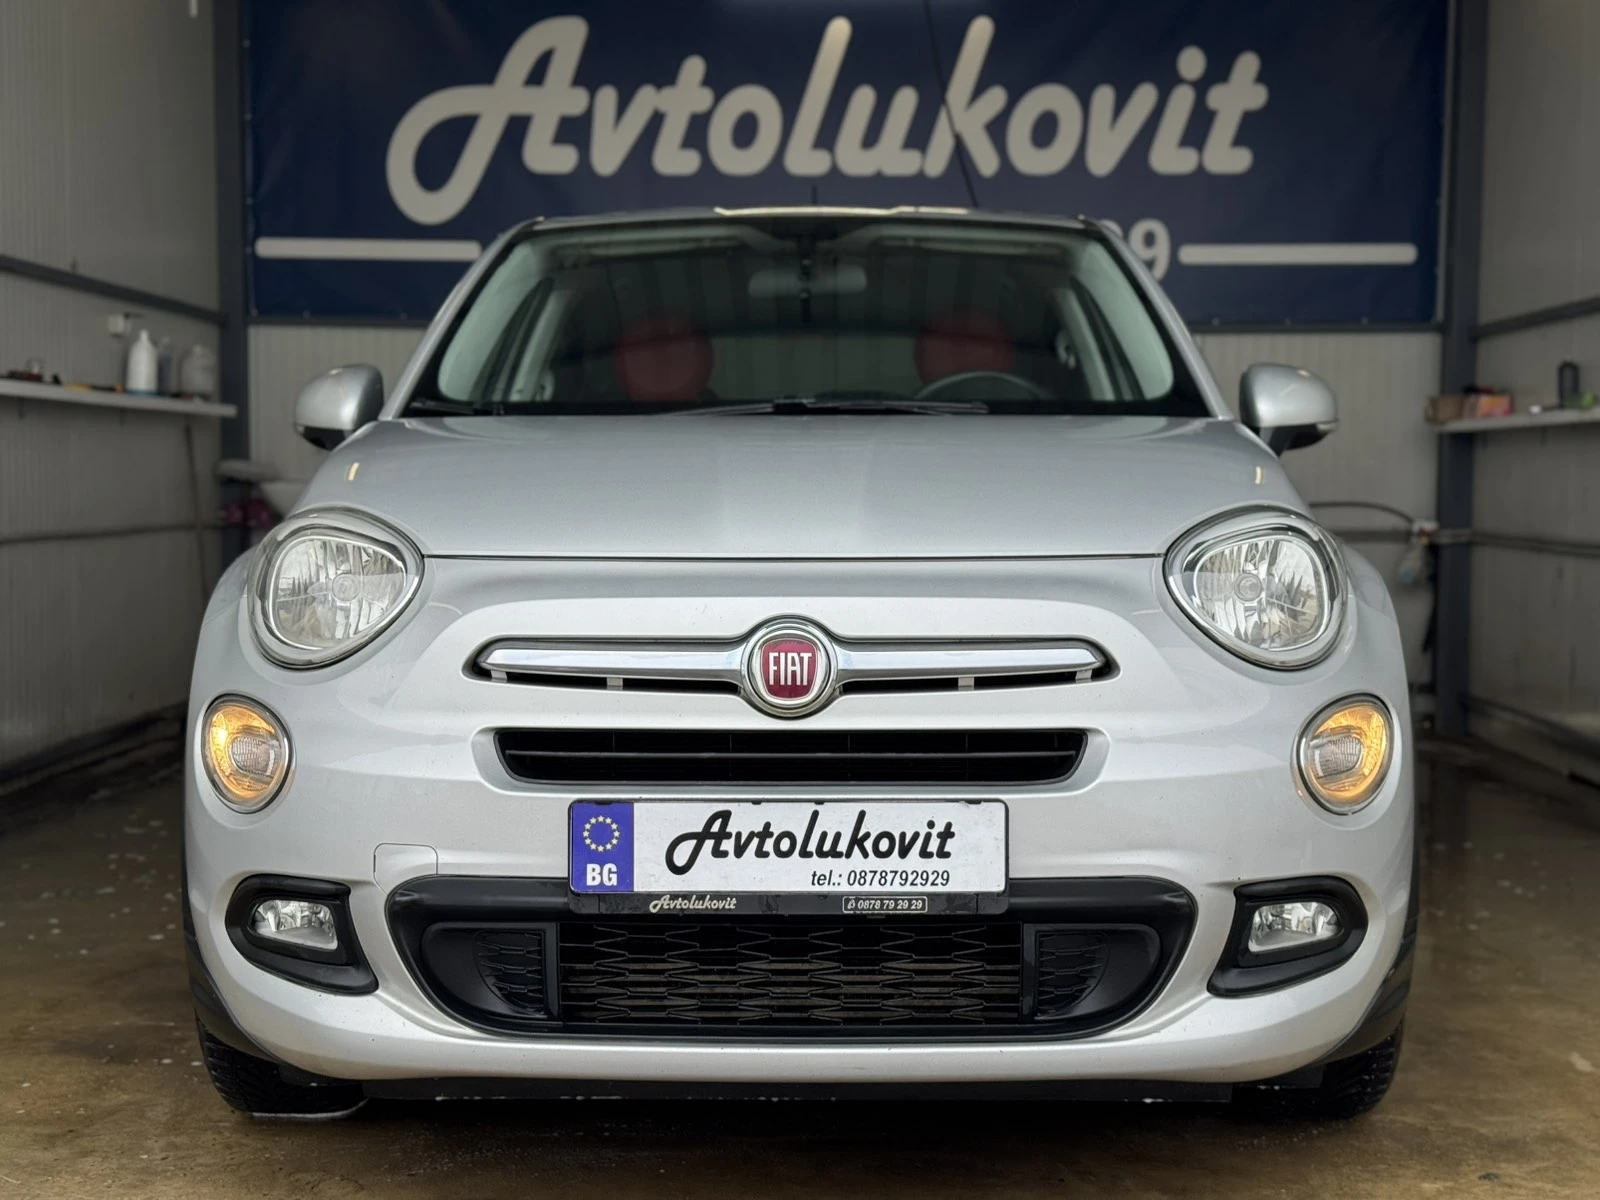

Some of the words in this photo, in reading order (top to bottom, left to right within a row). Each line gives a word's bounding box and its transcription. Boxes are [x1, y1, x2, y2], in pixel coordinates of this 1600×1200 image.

[386, 15, 1269, 225] Avtolukovit
[1100, 218, 1171, 281] 9
[768, 652, 812, 686] FIAT
[665, 809, 956, 876] Avtolukovit
[586, 863, 618, 886] BG
[811, 869, 842, 886] tel.:
[847, 869, 950, 887] 0878792929
[649, 894, 737, 913] Avtolukovit
[857, 899, 881, 910] 0878
[882, 899, 895, 910] 79
[896, 899, 909, 910] 29
[910, 899, 923, 910] 29
